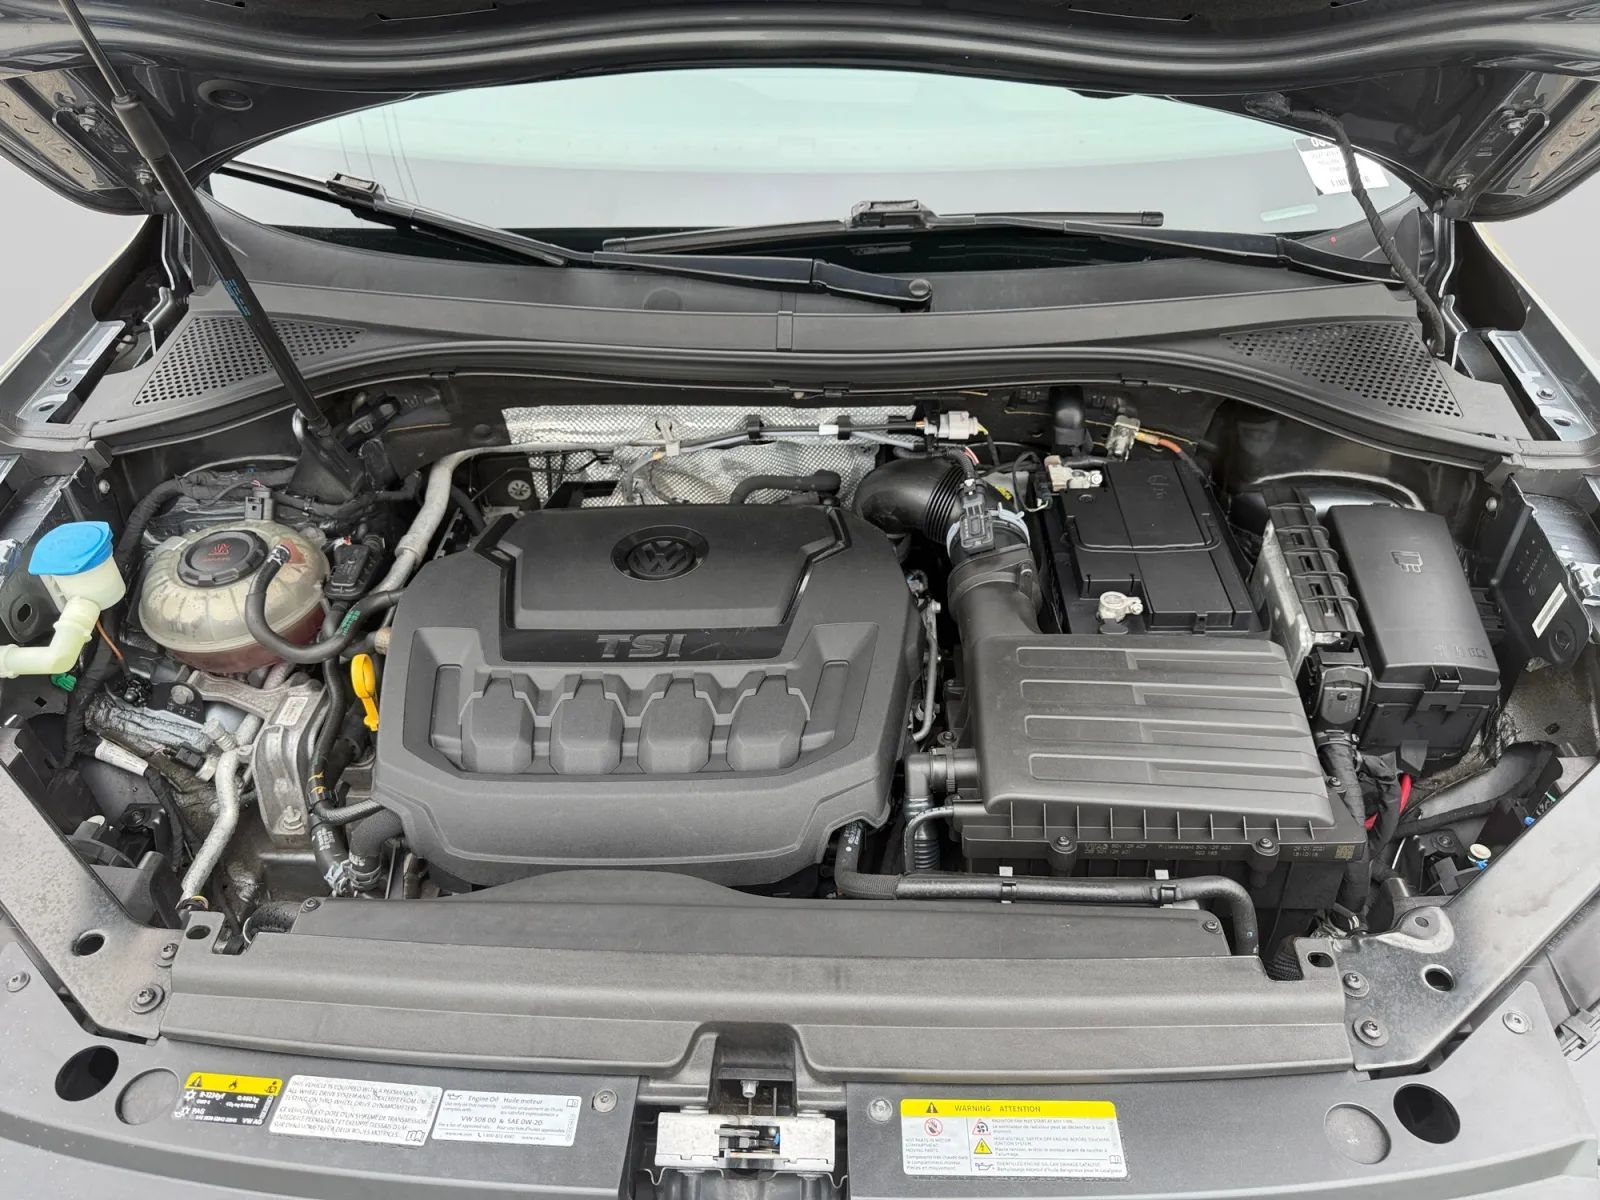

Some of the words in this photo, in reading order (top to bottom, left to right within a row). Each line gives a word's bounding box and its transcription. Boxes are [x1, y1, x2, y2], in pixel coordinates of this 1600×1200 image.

[597, 634, 687, 658] TSI
[955, 1104, 991, 1112] WARNING
[1000, 1105, 1041, 1113] ATTENTION
